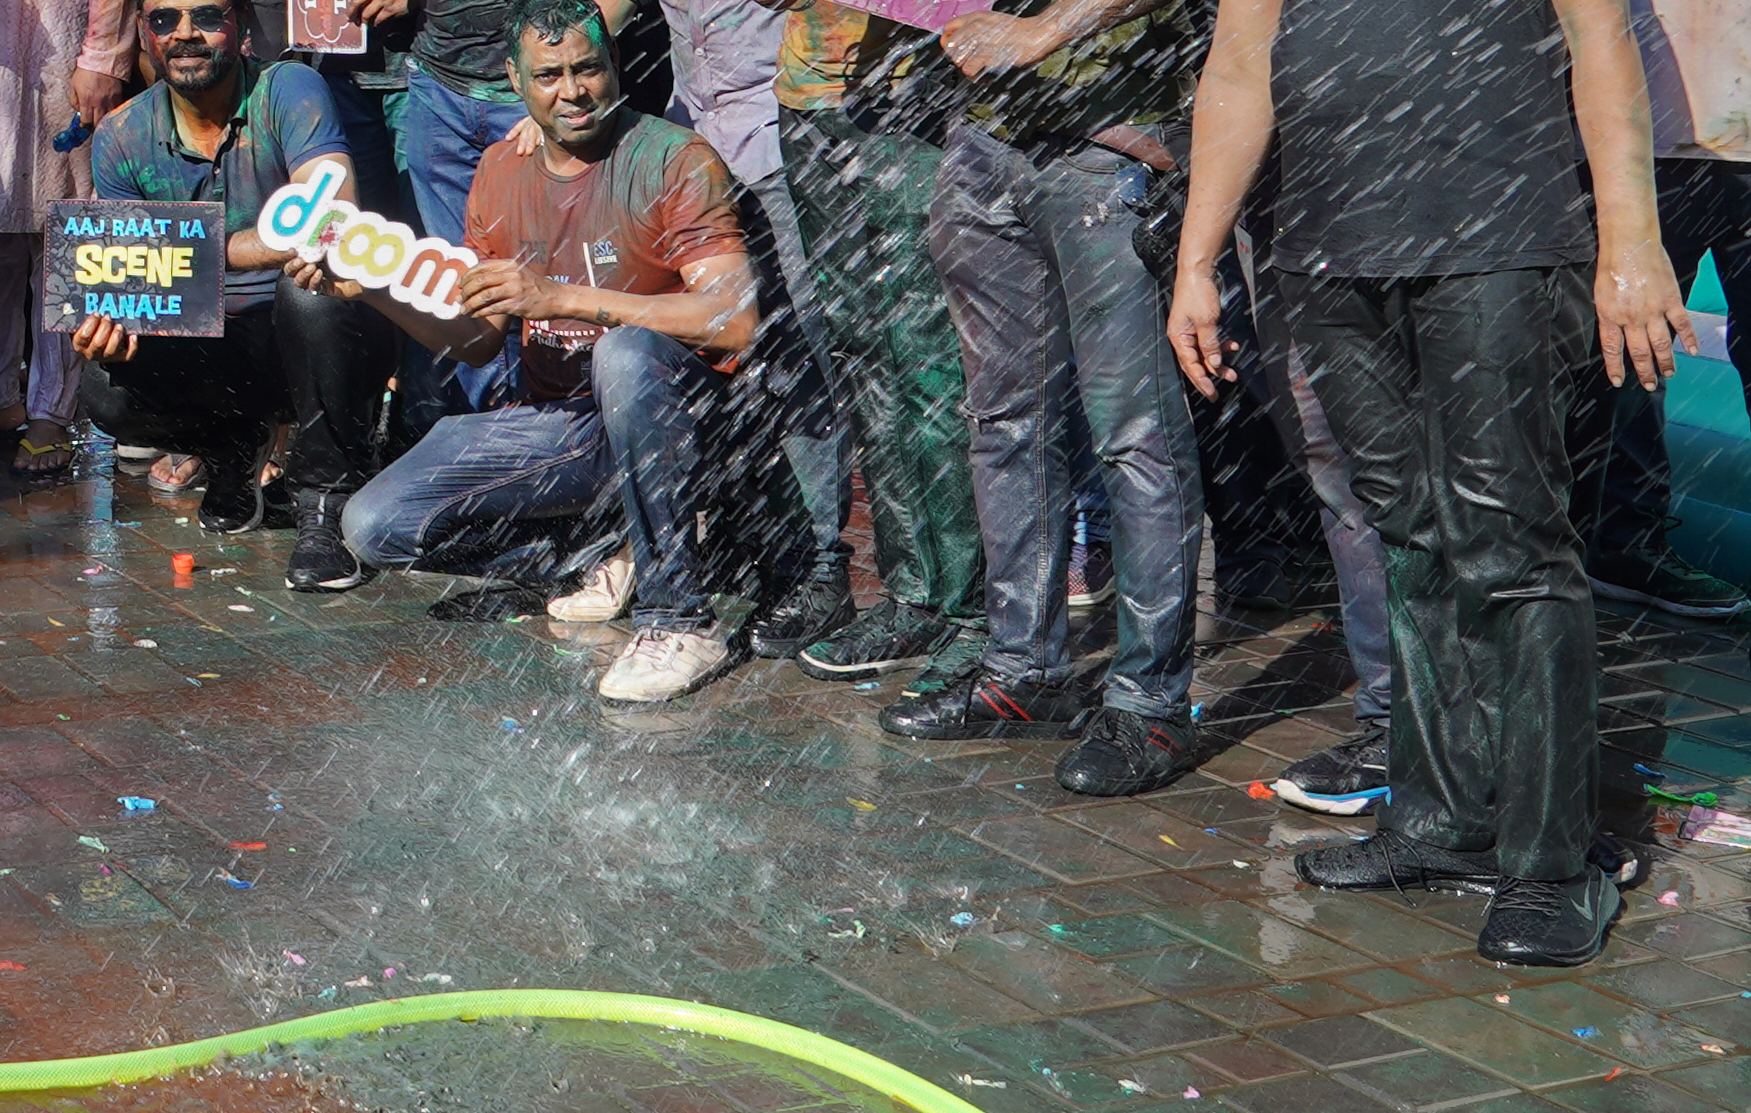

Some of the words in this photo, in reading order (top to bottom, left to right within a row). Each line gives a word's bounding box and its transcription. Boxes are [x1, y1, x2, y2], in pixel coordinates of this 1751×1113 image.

[63, 217, 105, 237] AAJ
[112, 218, 172, 238] RAAT
[179, 219, 206, 239] KA
[271, 171, 469, 306] droom
[74, 244, 194, 288] SCENE
[85, 292, 182, 321] BANALE
